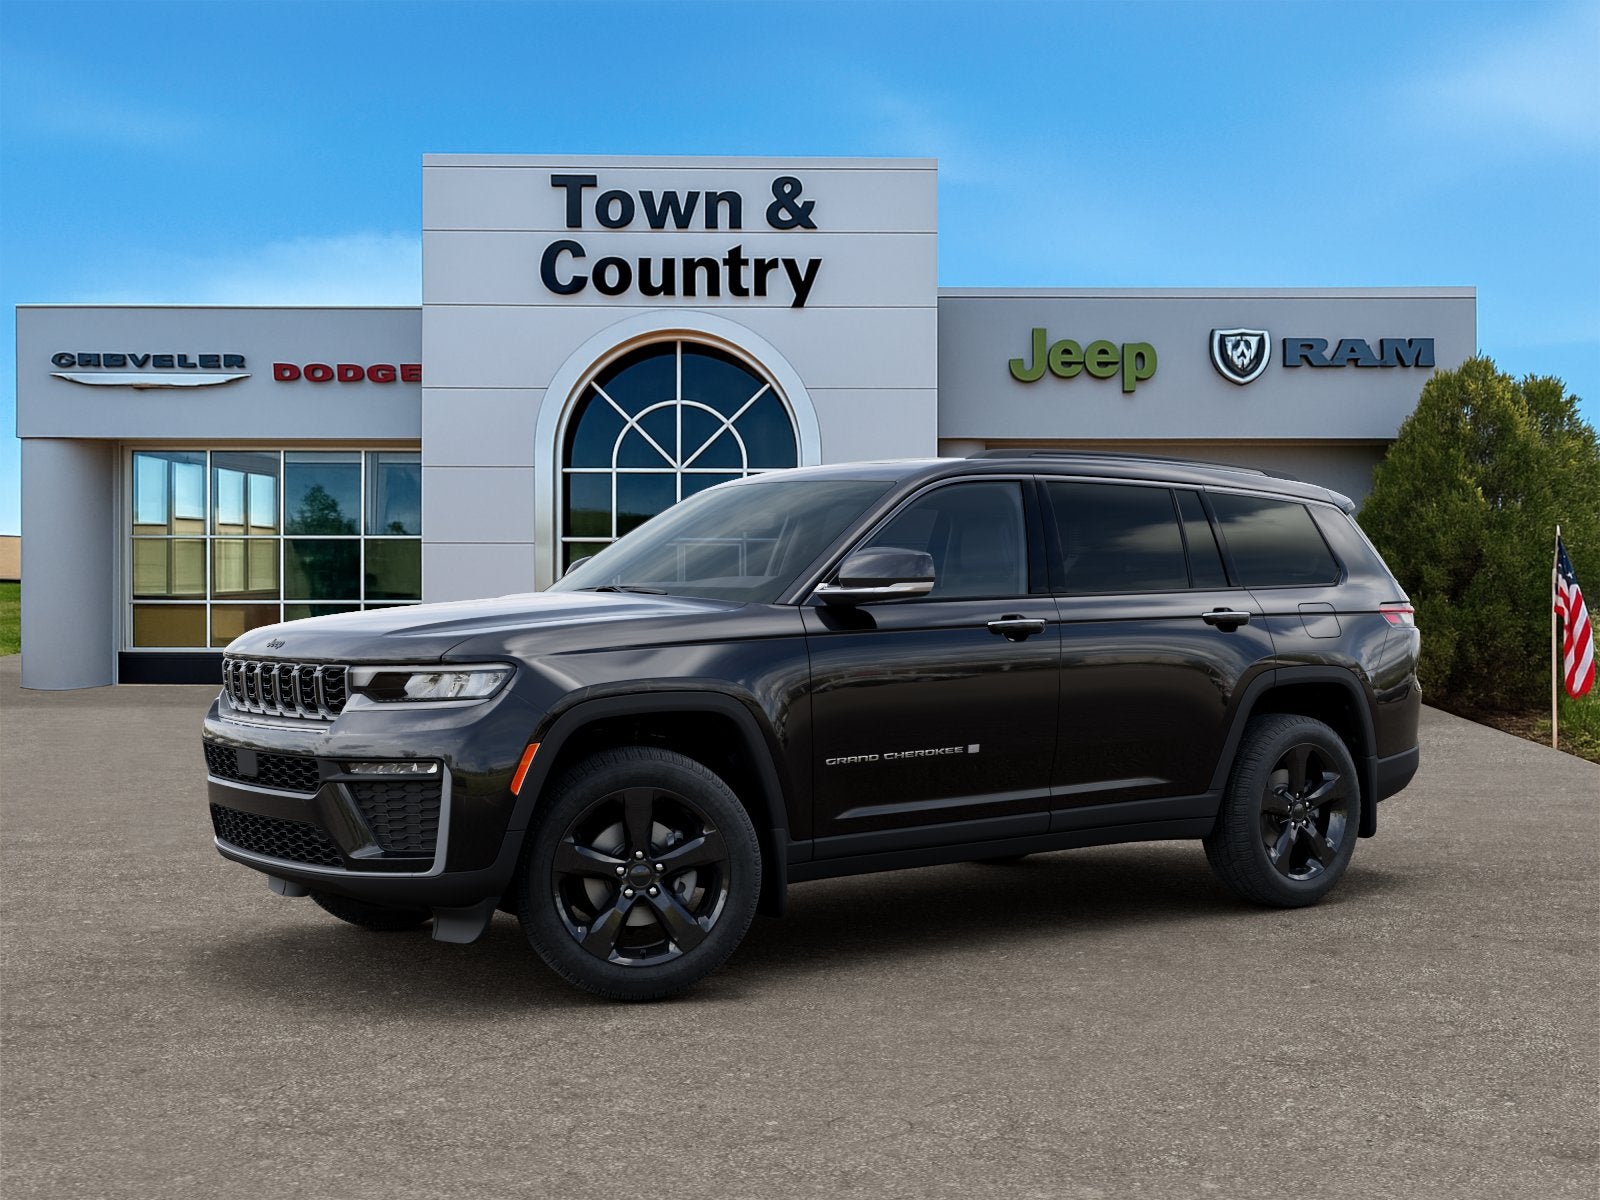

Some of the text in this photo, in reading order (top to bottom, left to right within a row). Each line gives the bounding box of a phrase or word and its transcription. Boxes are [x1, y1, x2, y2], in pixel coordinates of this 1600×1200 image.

[550, 174, 818, 230] Town &
[540, 239, 822, 308] Country
[272, 362, 421, 383] DODGE
[1009, 328, 1157, 393] Jeep
[1282, 338, 1435, 368] RAM
[825, 746, 964, 766] GRAND CHEROKEE
